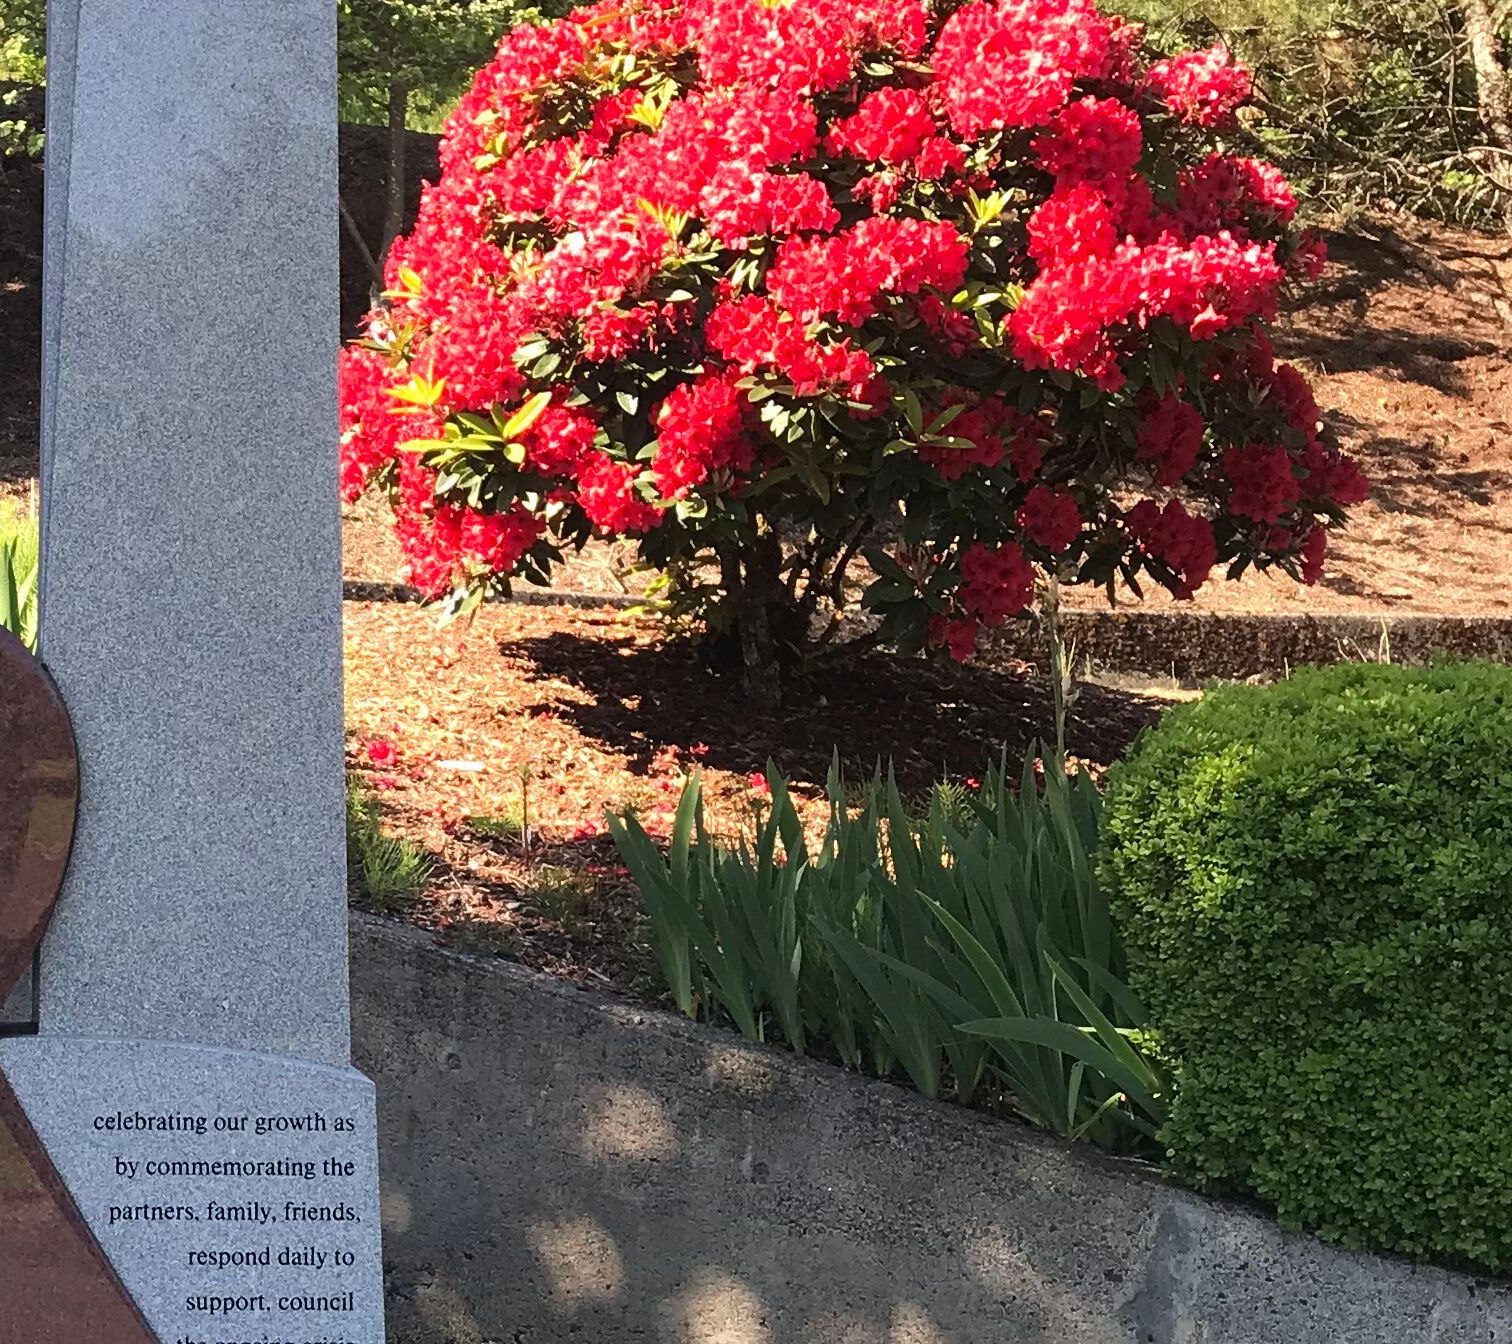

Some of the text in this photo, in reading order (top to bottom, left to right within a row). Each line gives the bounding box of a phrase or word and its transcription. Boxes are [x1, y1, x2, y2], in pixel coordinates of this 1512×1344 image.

[94, 1112, 354, 1135] celebrating our growth as
[115, 1157, 354, 1180] by commemorating the
[110, 1201, 360, 1224] partners, family, friends,
[189, 1247, 354, 1269] respond daily to
[186, 1292, 353, 1315] support, council
